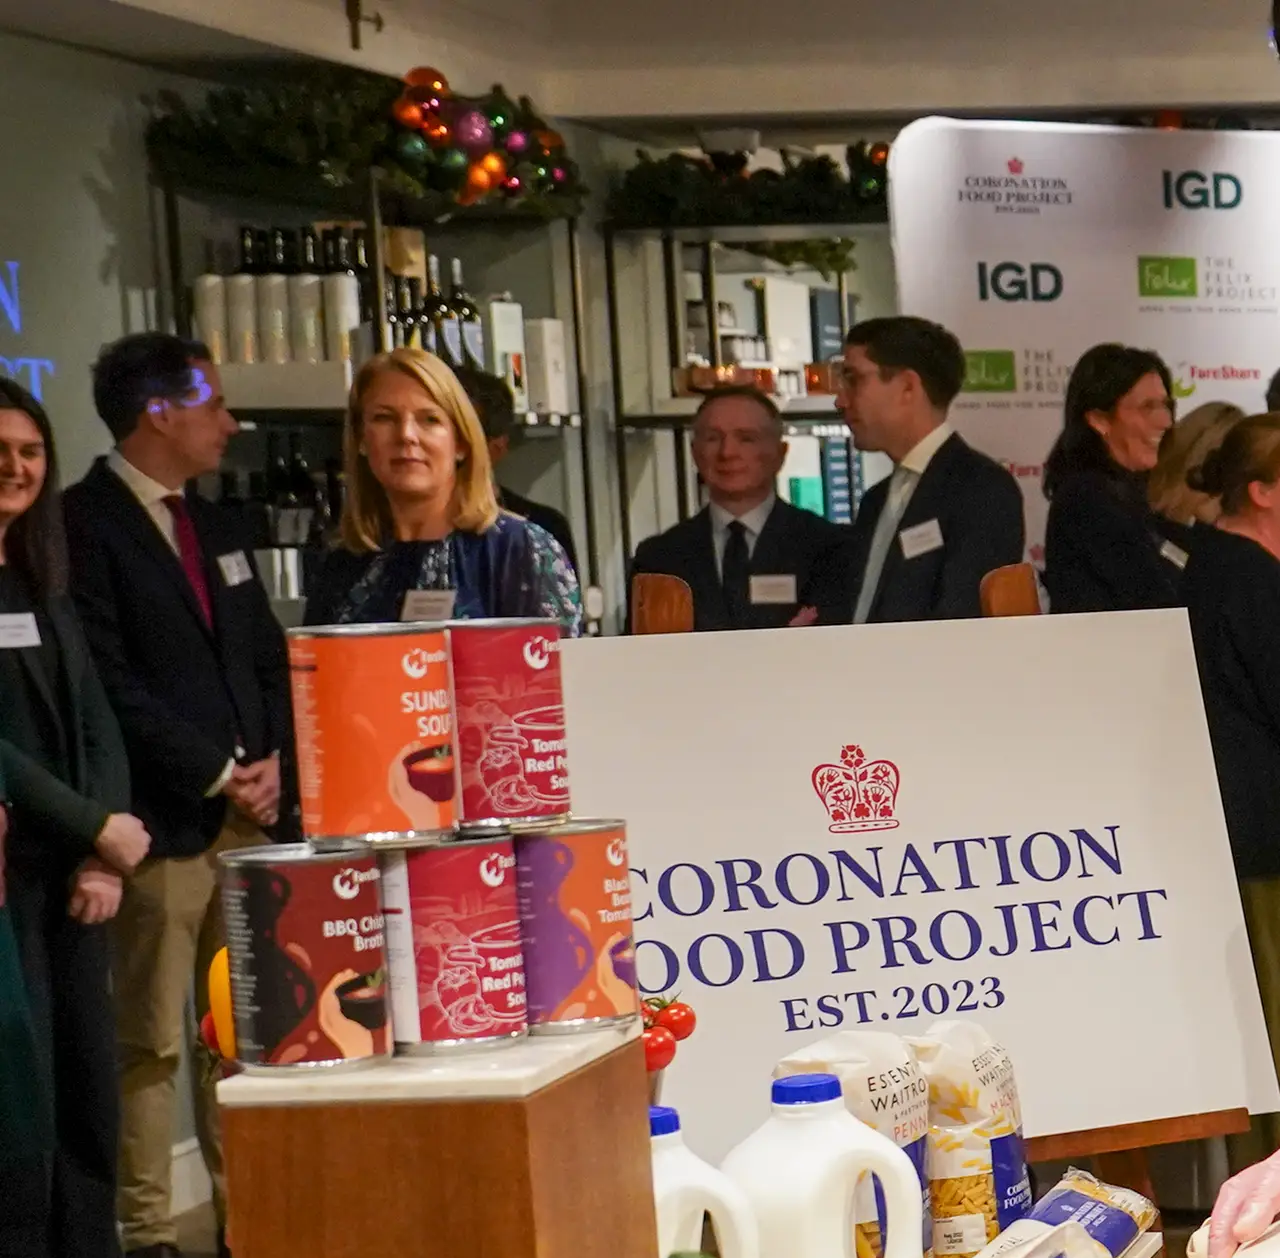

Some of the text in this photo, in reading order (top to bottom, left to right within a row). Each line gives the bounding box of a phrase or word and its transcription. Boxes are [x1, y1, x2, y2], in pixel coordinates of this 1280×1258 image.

[964, 176, 1068, 190] CORONATION
[1161, 169, 1243, 210] IGD
[958, 190, 1073, 205] FOOD PROJECT
[1204, 256, 1236, 269] THE
[976, 260, 1064, 302] IGD
[1204, 271, 1252, 284] FELIX
[1204, 286, 1277, 301] PROJECT
[1023, 350, 1054, 363] THE
[1190, 364, 1261, 382] FareShare
[322, 917, 359, 939] BBQ
[635, 888, 1168, 995] OOD PROJECT
[781, 975, 1006, 1033] EST.2023
[870, 1077, 927, 1113] WAITRO
[893, 1114, 928, 1142] PENN
